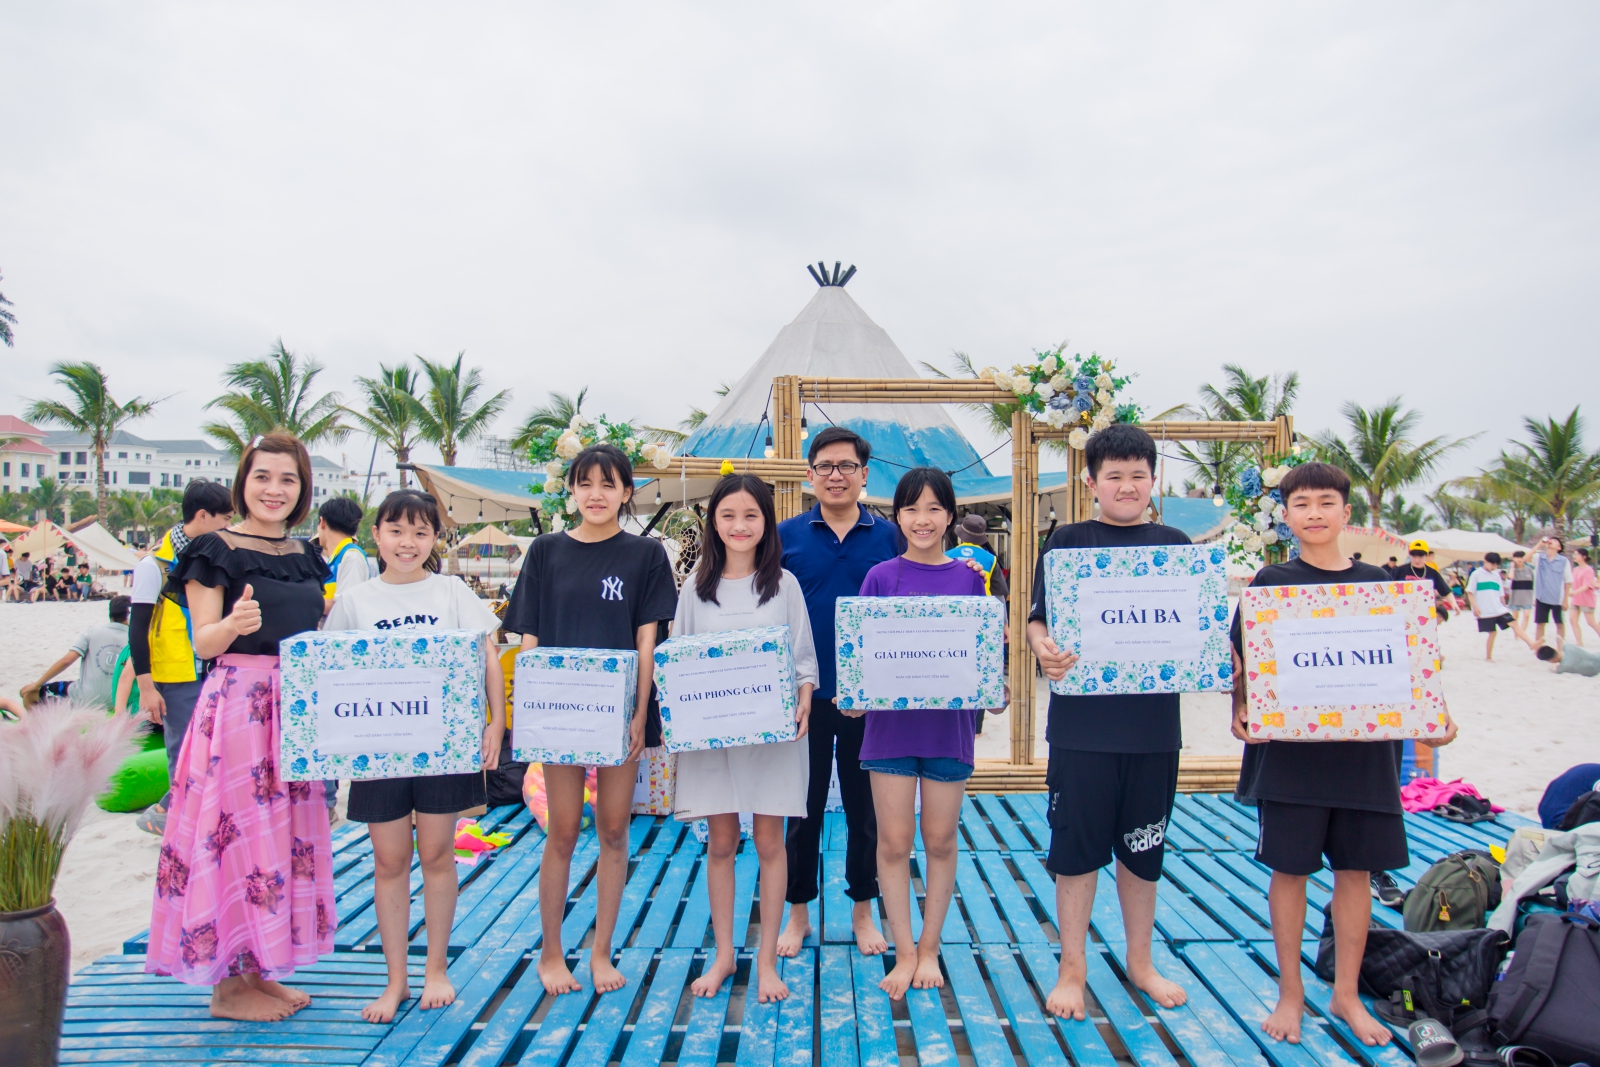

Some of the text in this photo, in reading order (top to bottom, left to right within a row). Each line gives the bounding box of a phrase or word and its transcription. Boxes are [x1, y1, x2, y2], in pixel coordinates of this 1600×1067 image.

[374, 614, 439, 630] BEANY
[1101, 605, 1182, 624] GIẢI BA
[874, 648, 967, 659] GIẢI PHONG CÁCH
[1293, 644, 1394, 667] GIẢI NHÌ
[680, 684, 772, 702] GIẢI PHONG CÁCH
[334, 696, 430, 718] GIẢI NHÌ
[524, 700, 615, 713] GIẢI PHONG CÁCH
[1126, 820, 1166, 853] adid
[1417, 1035, 1448, 1050] TikTok
